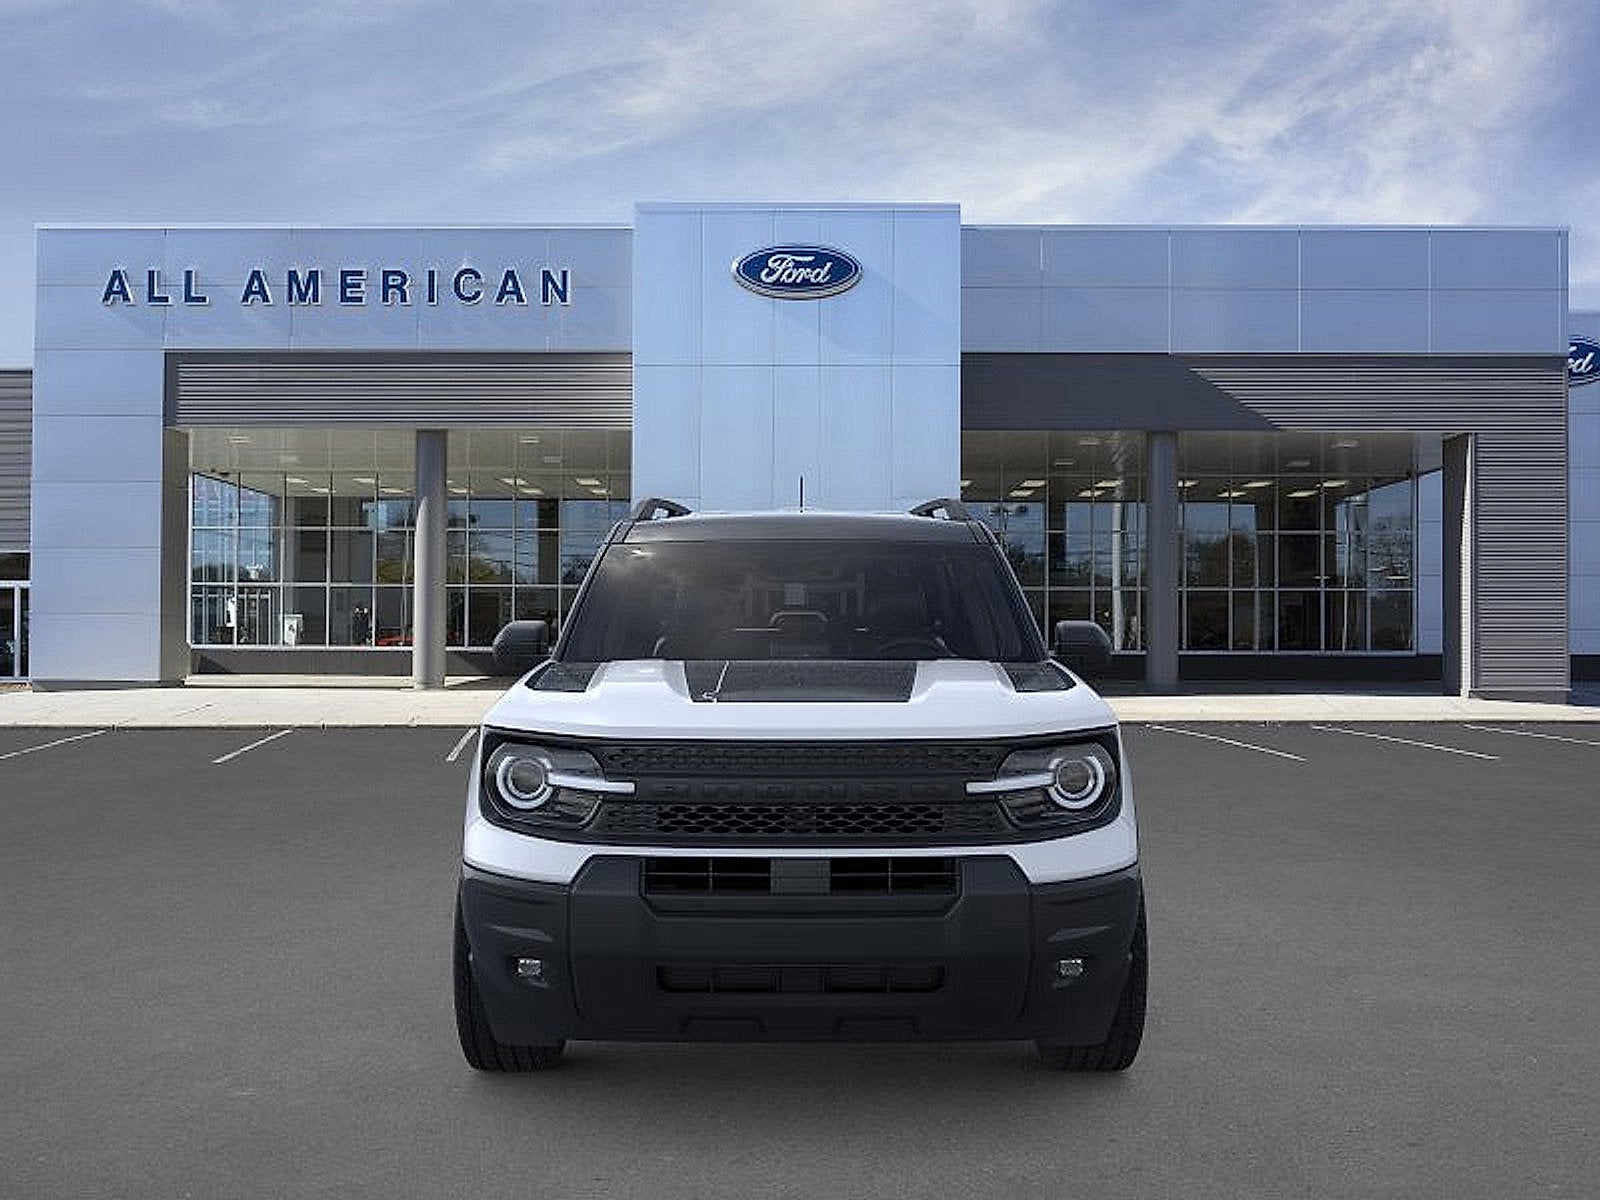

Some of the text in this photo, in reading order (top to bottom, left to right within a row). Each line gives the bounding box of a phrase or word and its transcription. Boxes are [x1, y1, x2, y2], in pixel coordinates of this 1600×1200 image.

[103, 266, 573, 307] ALL AMERICAN
[760, 254, 833, 284] Ford
